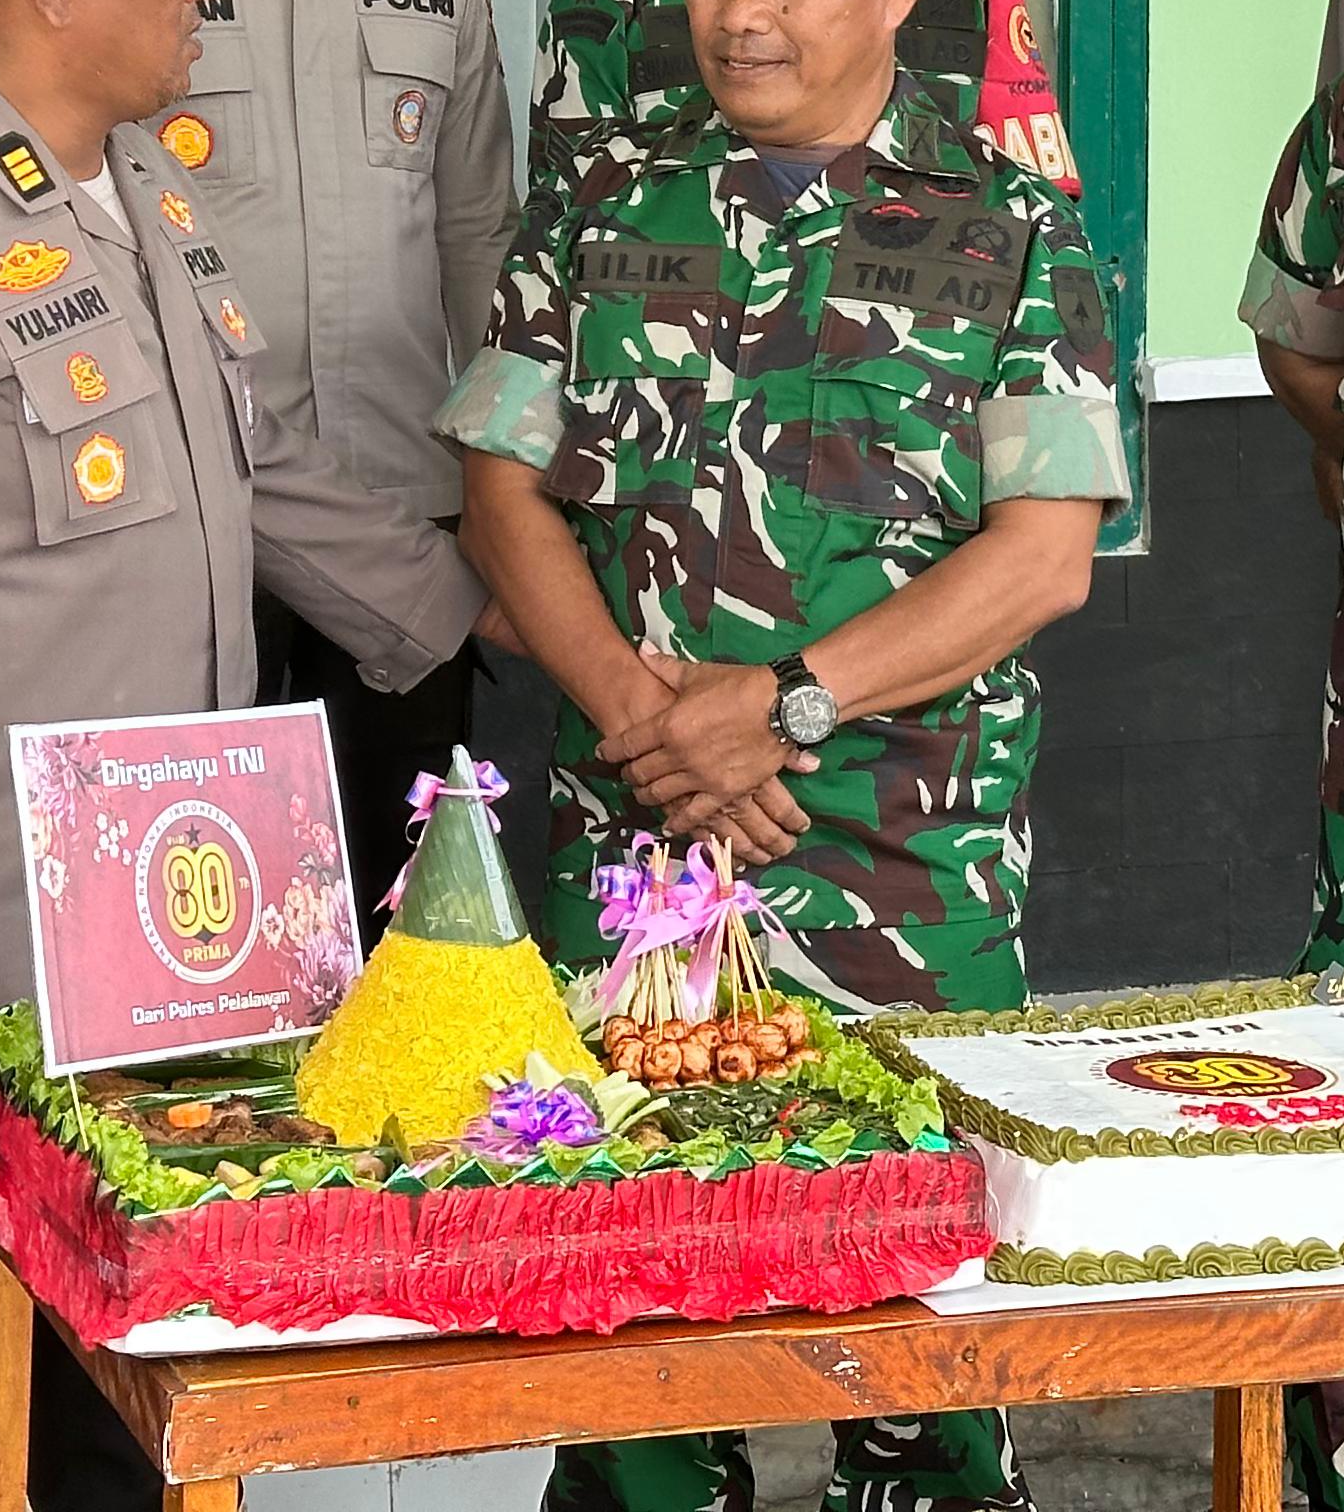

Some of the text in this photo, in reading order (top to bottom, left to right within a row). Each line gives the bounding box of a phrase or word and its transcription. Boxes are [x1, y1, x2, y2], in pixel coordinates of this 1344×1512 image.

[182, 245, 227, 280] POLRI
[577, 252, 693, 283] LILIK
[854, 262, 993, 313] TNI AD
[6, 285, 110, 346] YULHAIRI
[100, 744, 267, 792] Dirgahayu TNI
[161, 841, 238, 938] 80
[183, 943, 233, 963] PRIMA
[131, 990, 291, 1026] Dari Polres Pelalawan
[1133, 1057, 1295, 1088] 80
